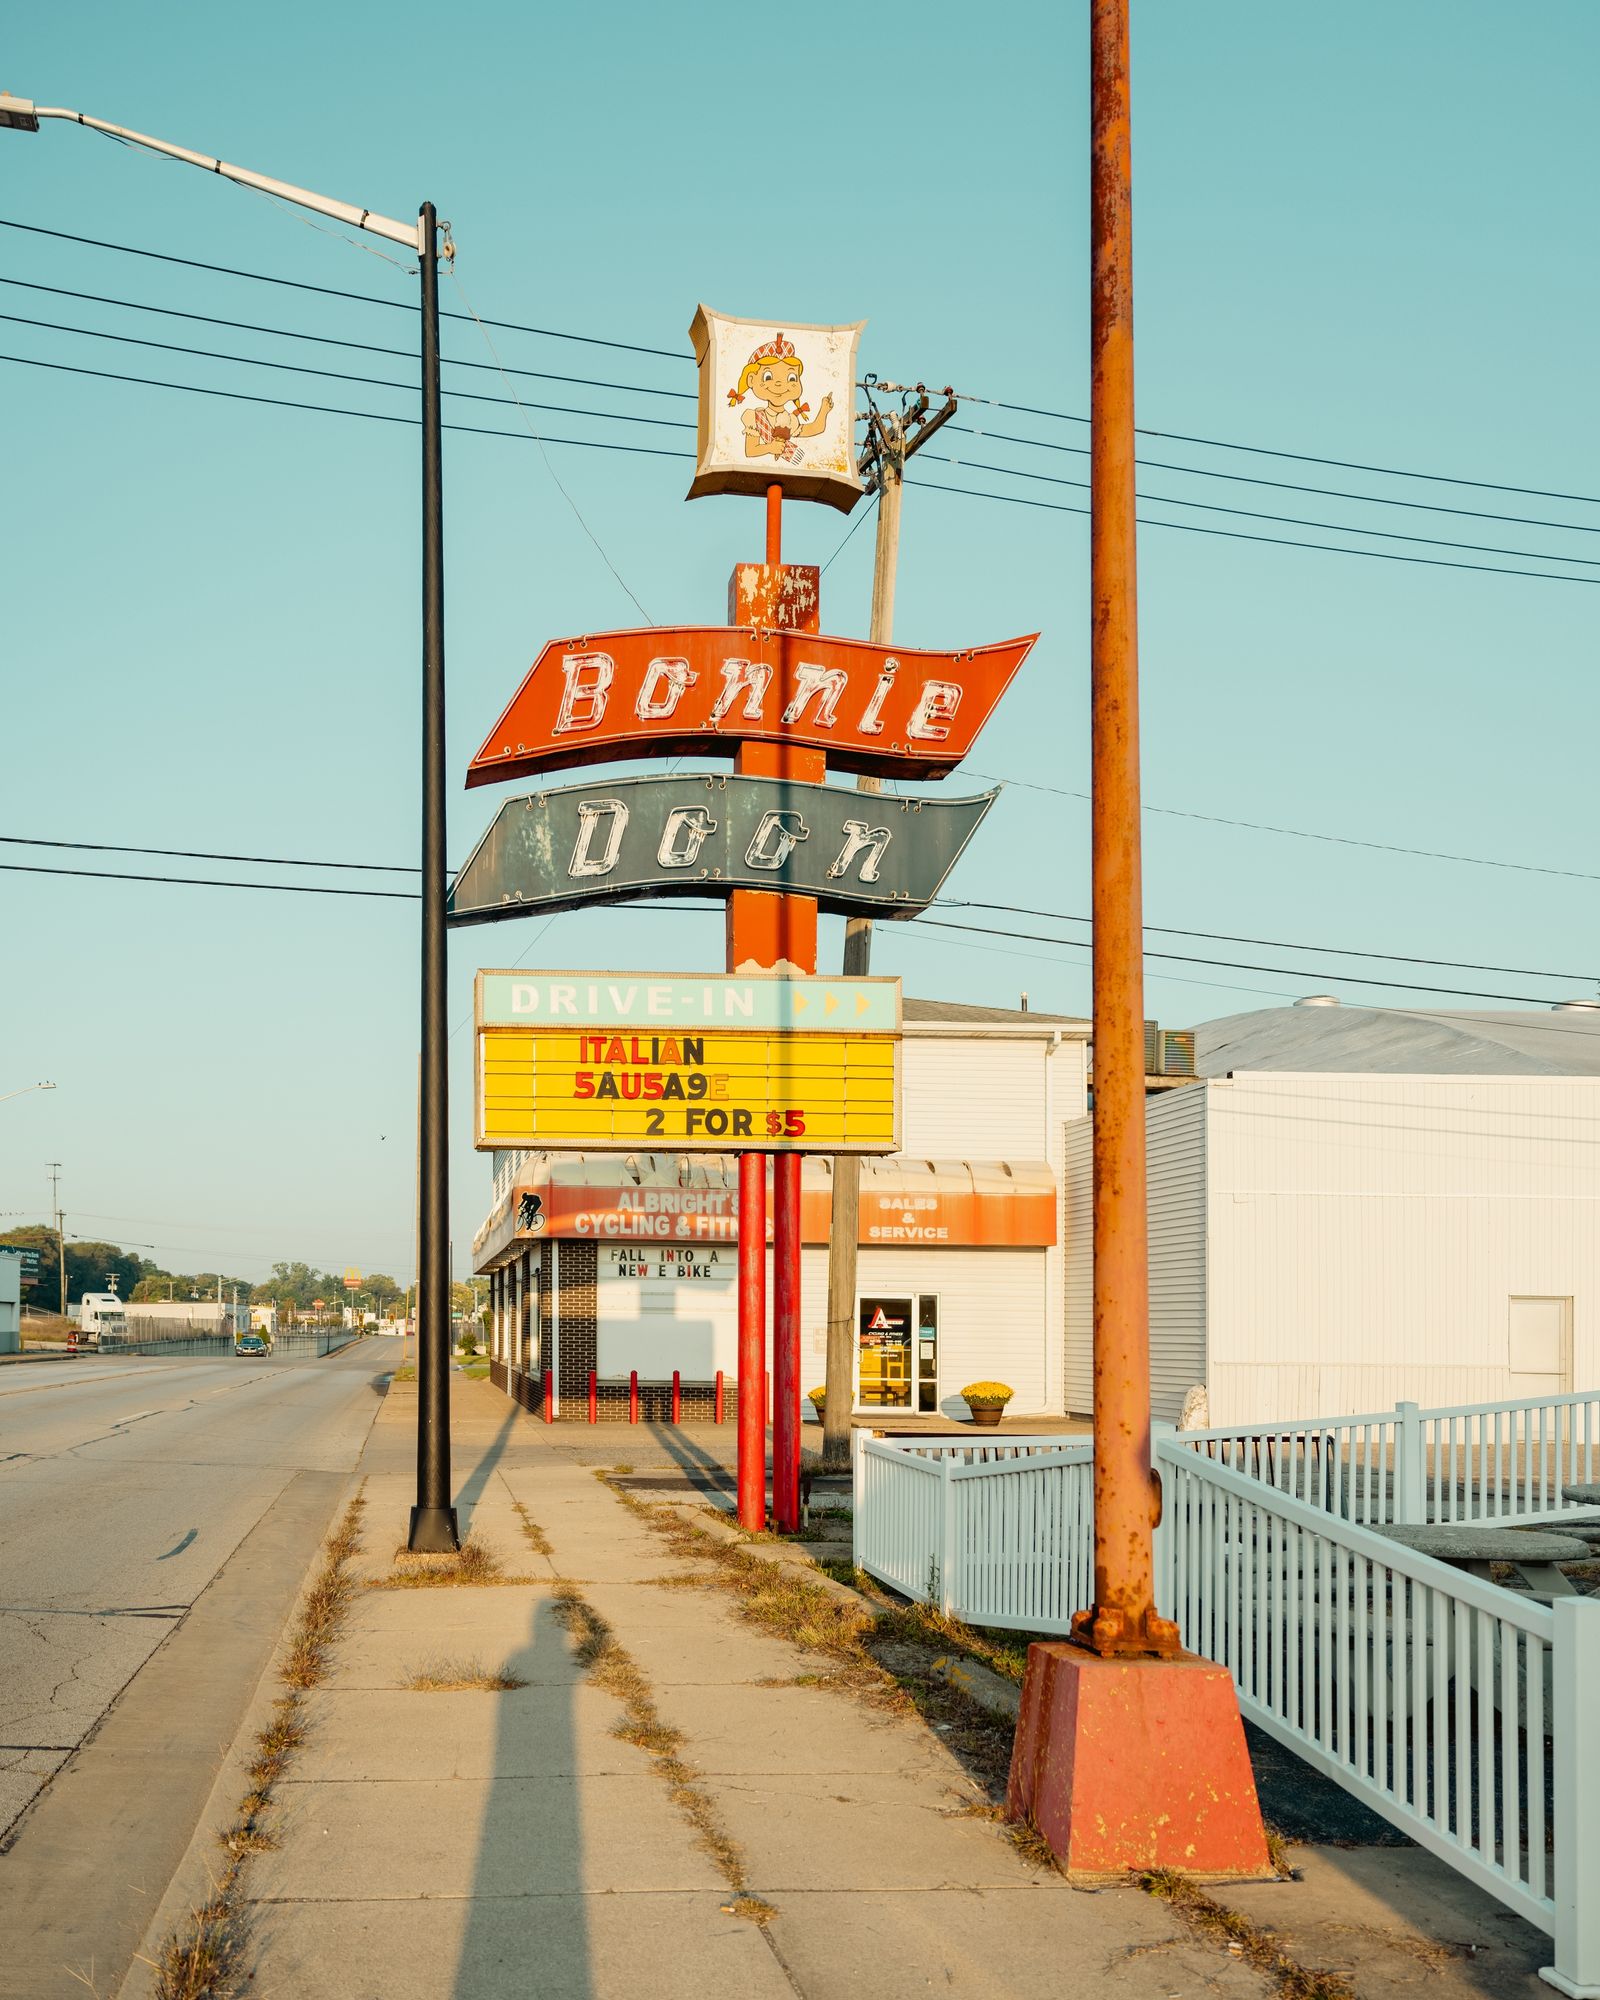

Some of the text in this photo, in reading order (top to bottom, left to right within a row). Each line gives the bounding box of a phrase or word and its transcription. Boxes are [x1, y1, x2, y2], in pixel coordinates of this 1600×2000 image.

[551, 651, 964, 740] Bonnie
[567, 798, 894, 884] Doon
[512, 984, 754, 1017] DRIVE-IN
[580, 1036, 704, 1065] ITALIAN
[646, 1108, 806, 1137] 2 FOR $5
[879, 1197, 938, 1210] SALES
[575, 1213, 670, 1235] CYCLING
[675, 1216, 691, 1236] &
[902, 1212, 915, 1224] &
[869, 1226, 949, 1239] SERVICE
[610, 1249, 718, 1263] FALL INTO A
[619, 1264, 711, 1277] NEW E BIKE
